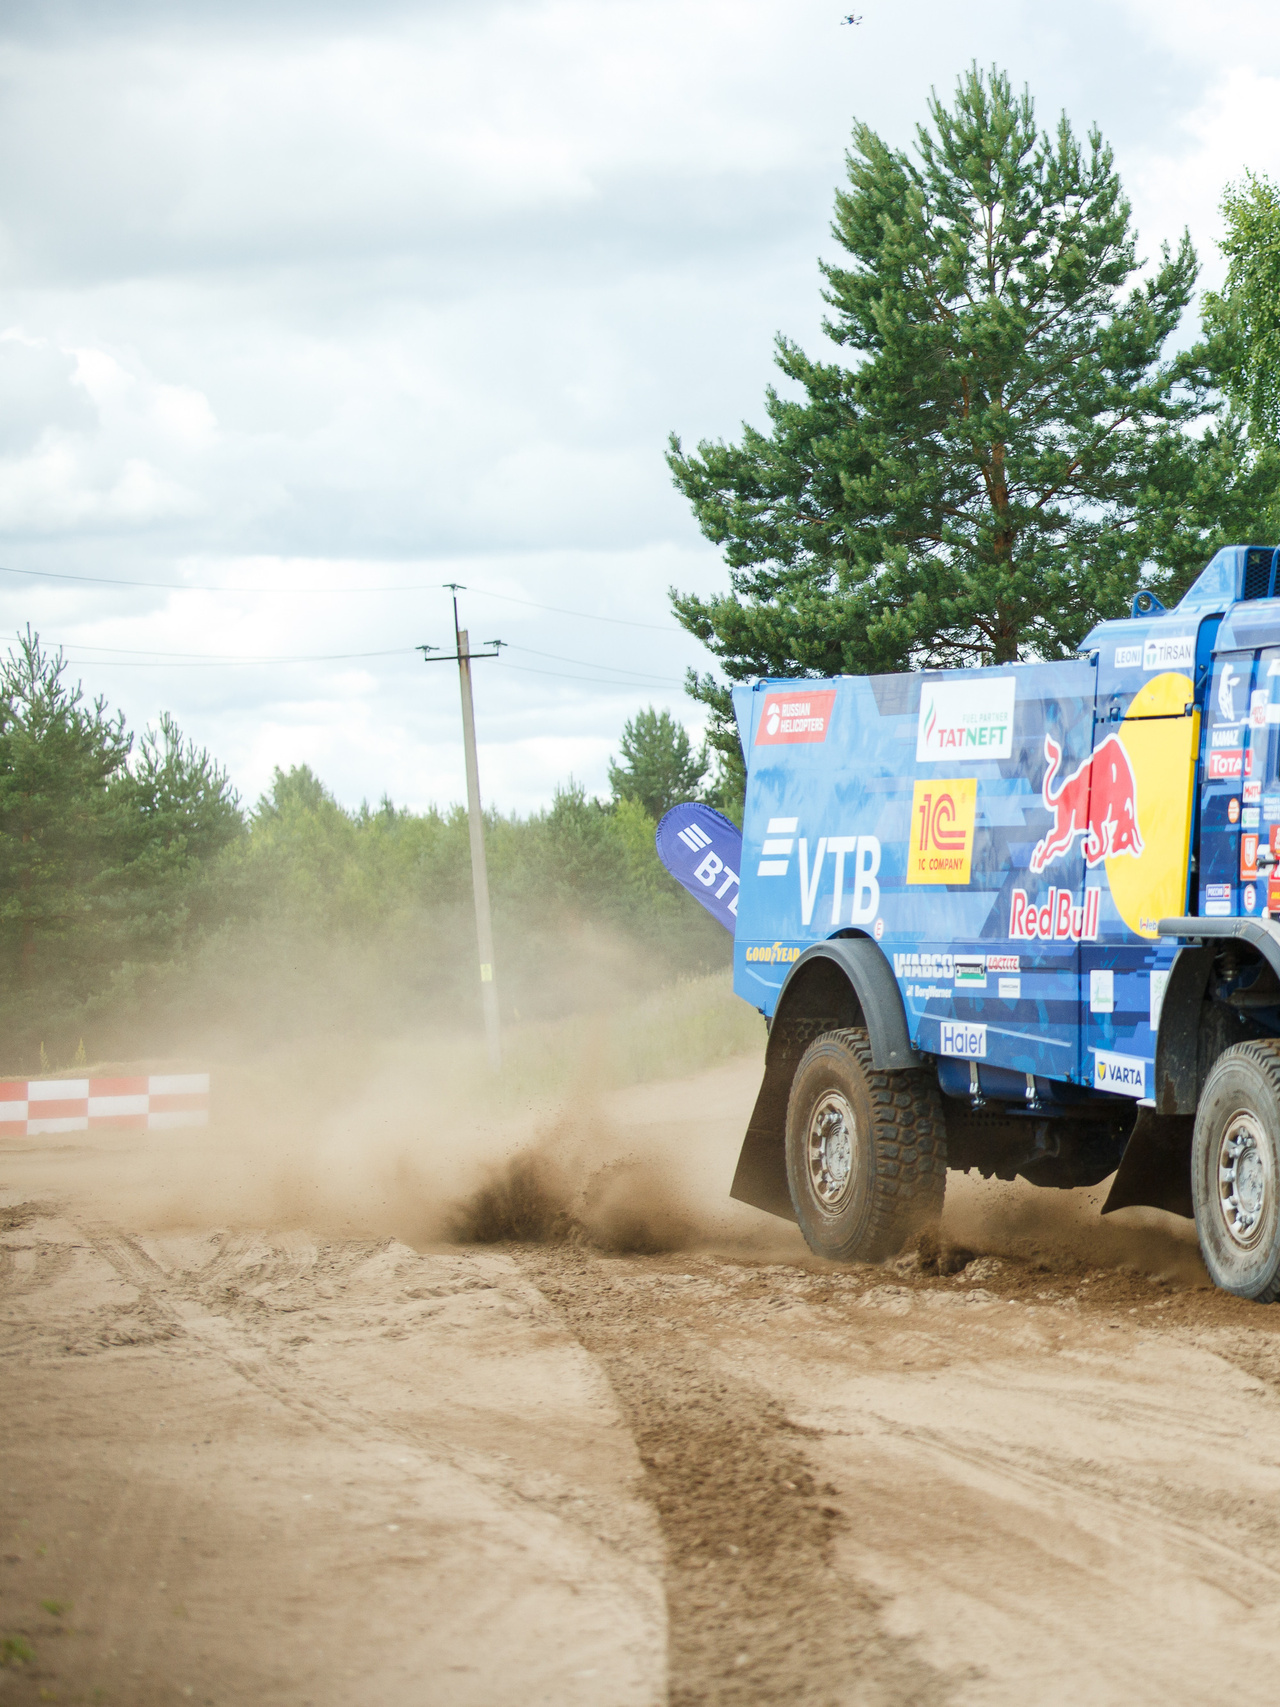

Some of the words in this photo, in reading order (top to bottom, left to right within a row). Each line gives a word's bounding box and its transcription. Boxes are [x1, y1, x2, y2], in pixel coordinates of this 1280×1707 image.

[1116, 650, 1141, 664] LEONI
[782, 703, 811, 717] RUSSIAN
[962, 713, 977, 723] FUEL
[979, 712, 1008, 723] PARTNER
[780, 718, 824, 733] HELICOPTERS
[938, 726, 1007, 748] TATNEFT
[1212, 729, 1239, 747] KAMAZ
[1211, 754, 1251, 773] TOTAL
[919, 793, 966, 851] 1C
[929, 858, 964, 871] COMPANY
[693, 850, 740, 917] ВТ
[799, 835, 882, 926] VTB
[1009, 888, 1055, 937] Red
[1055, 886, 1100, 940] Bull
[746, 942, 801, 965] GOODYEAR
[987, 956, 1019, 970] LOCTITE
[893, 953, 955, 979] WABCO
[943, 1026, 983, 1055] Haier
[1108, 1064, 1142, 1086] VARTA
